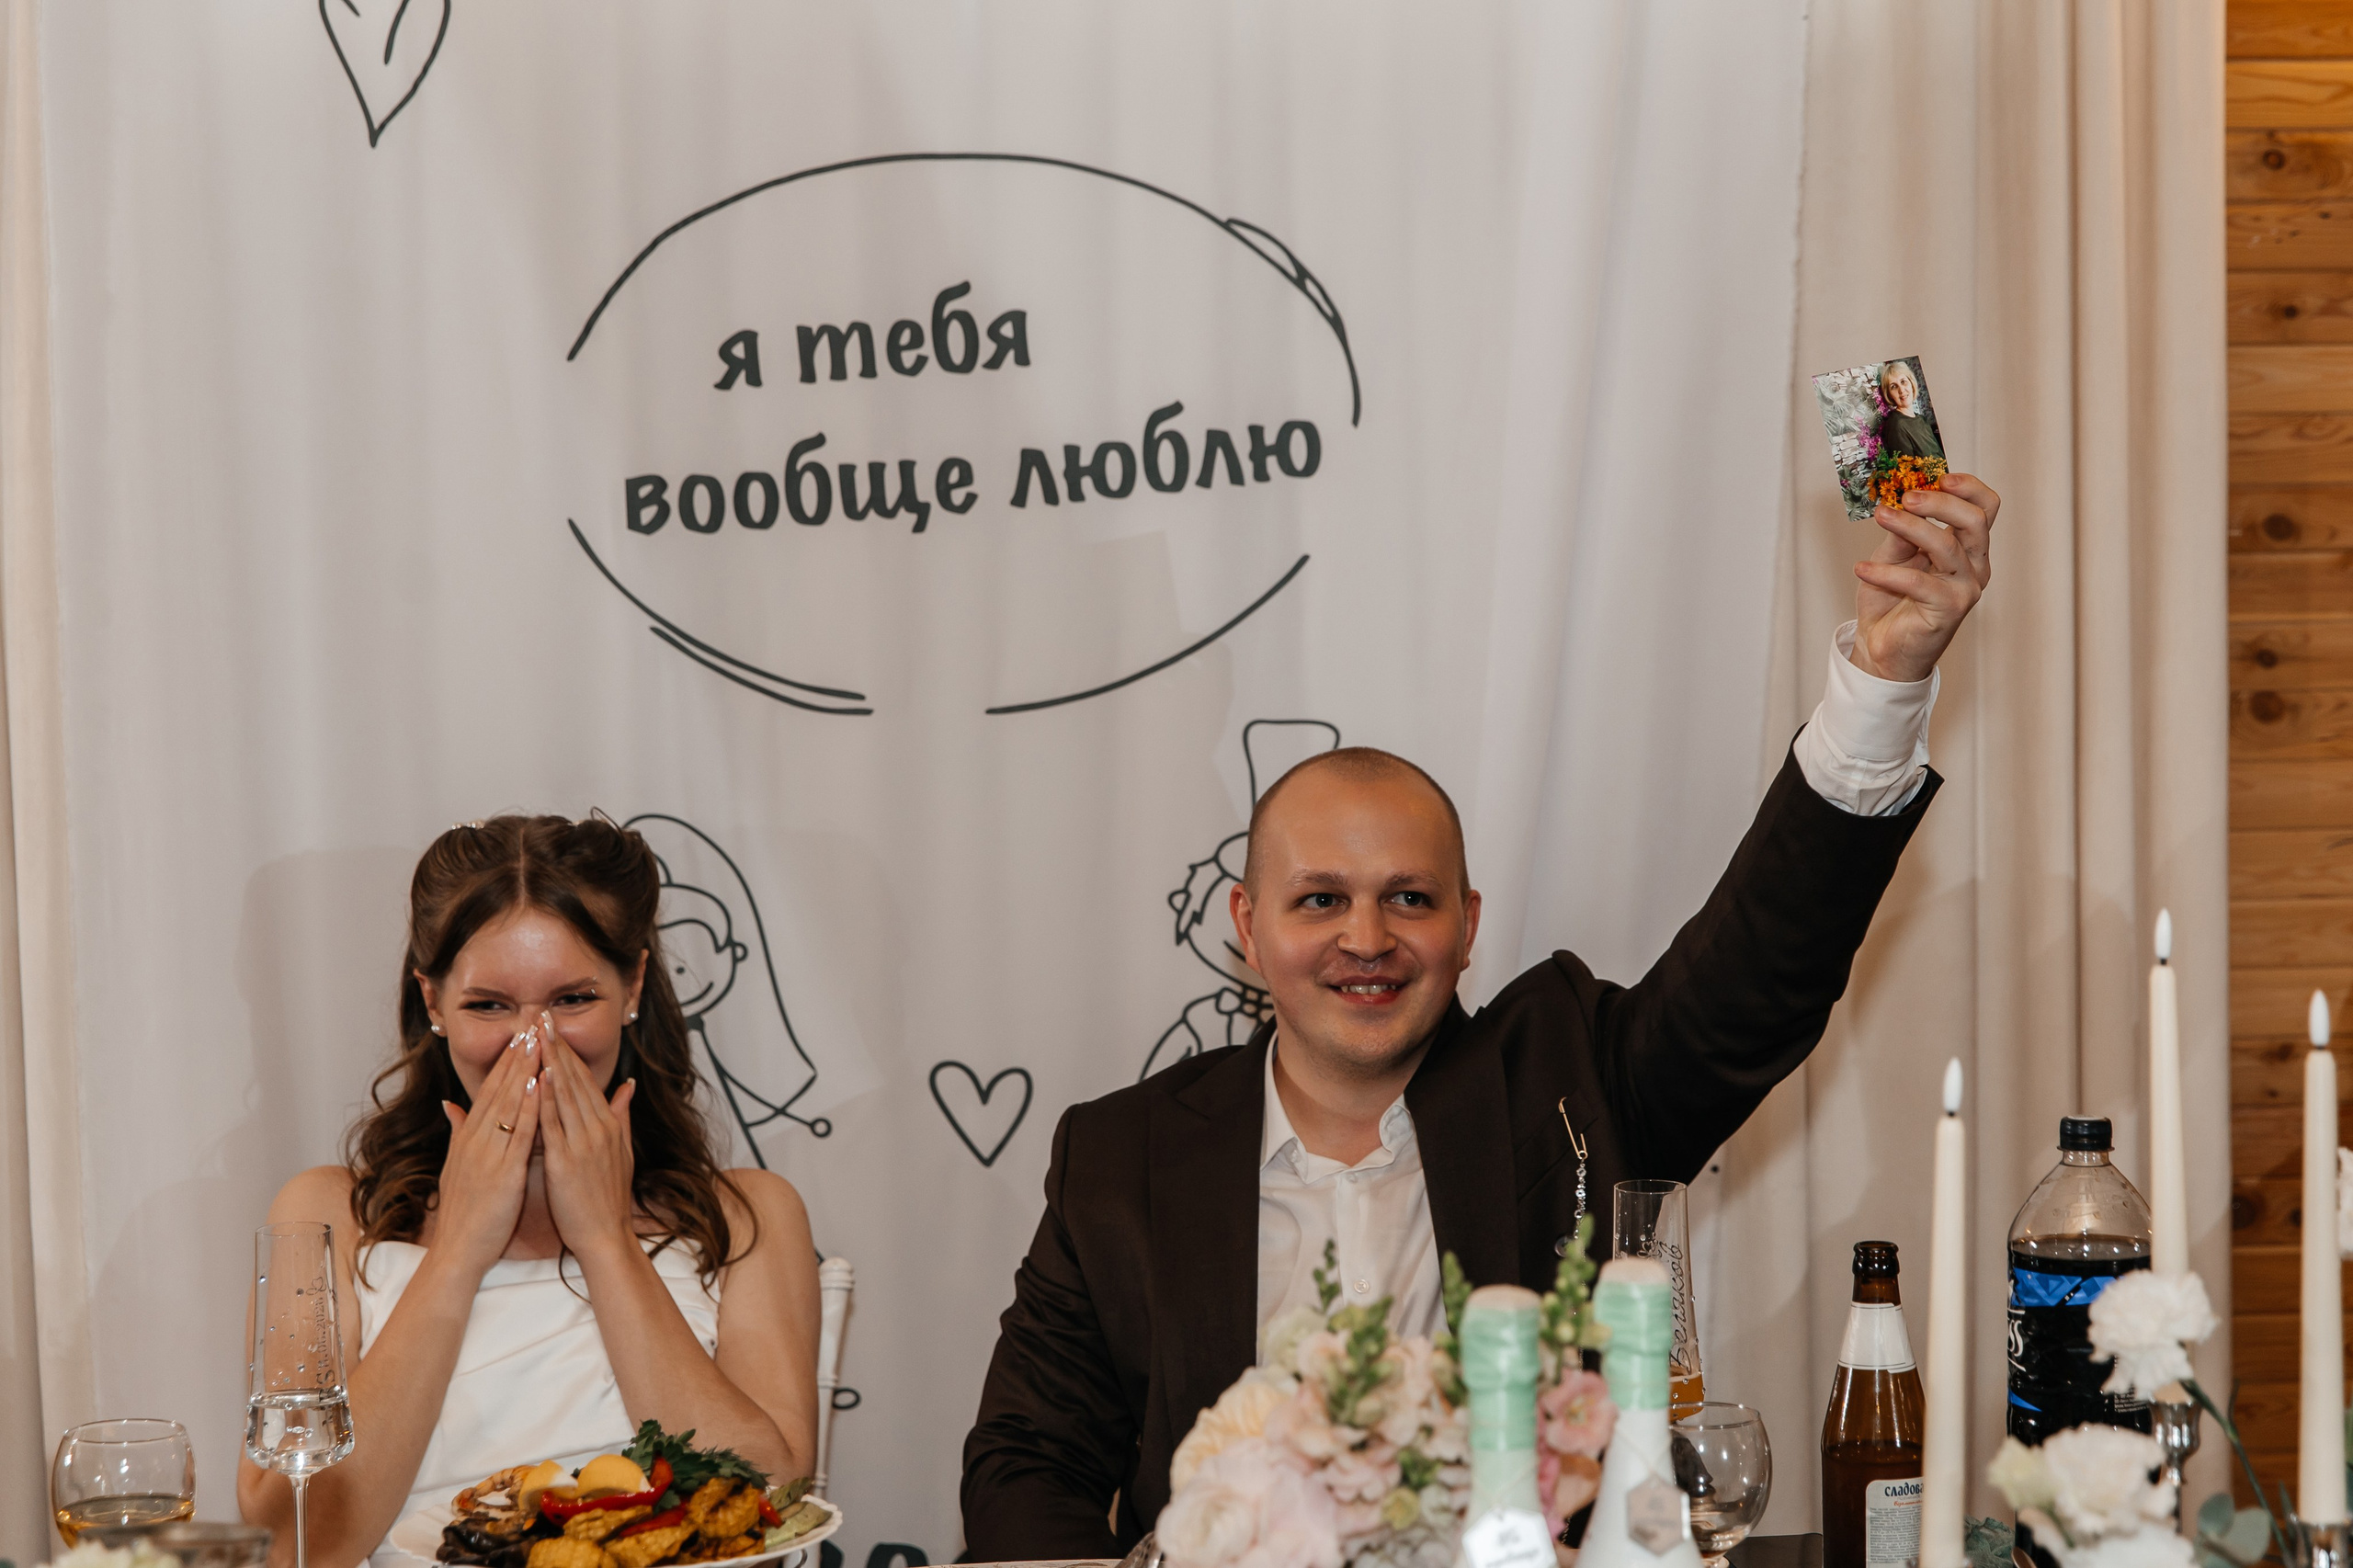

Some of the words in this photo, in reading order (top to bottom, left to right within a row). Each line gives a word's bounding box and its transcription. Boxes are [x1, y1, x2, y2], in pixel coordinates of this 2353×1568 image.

[714, 330, 762, 391] я
[797, 281, 1030, 383] тебя
[626, 433, 978, 535] вообще
[1010, 402, 1321, 508] люблю
